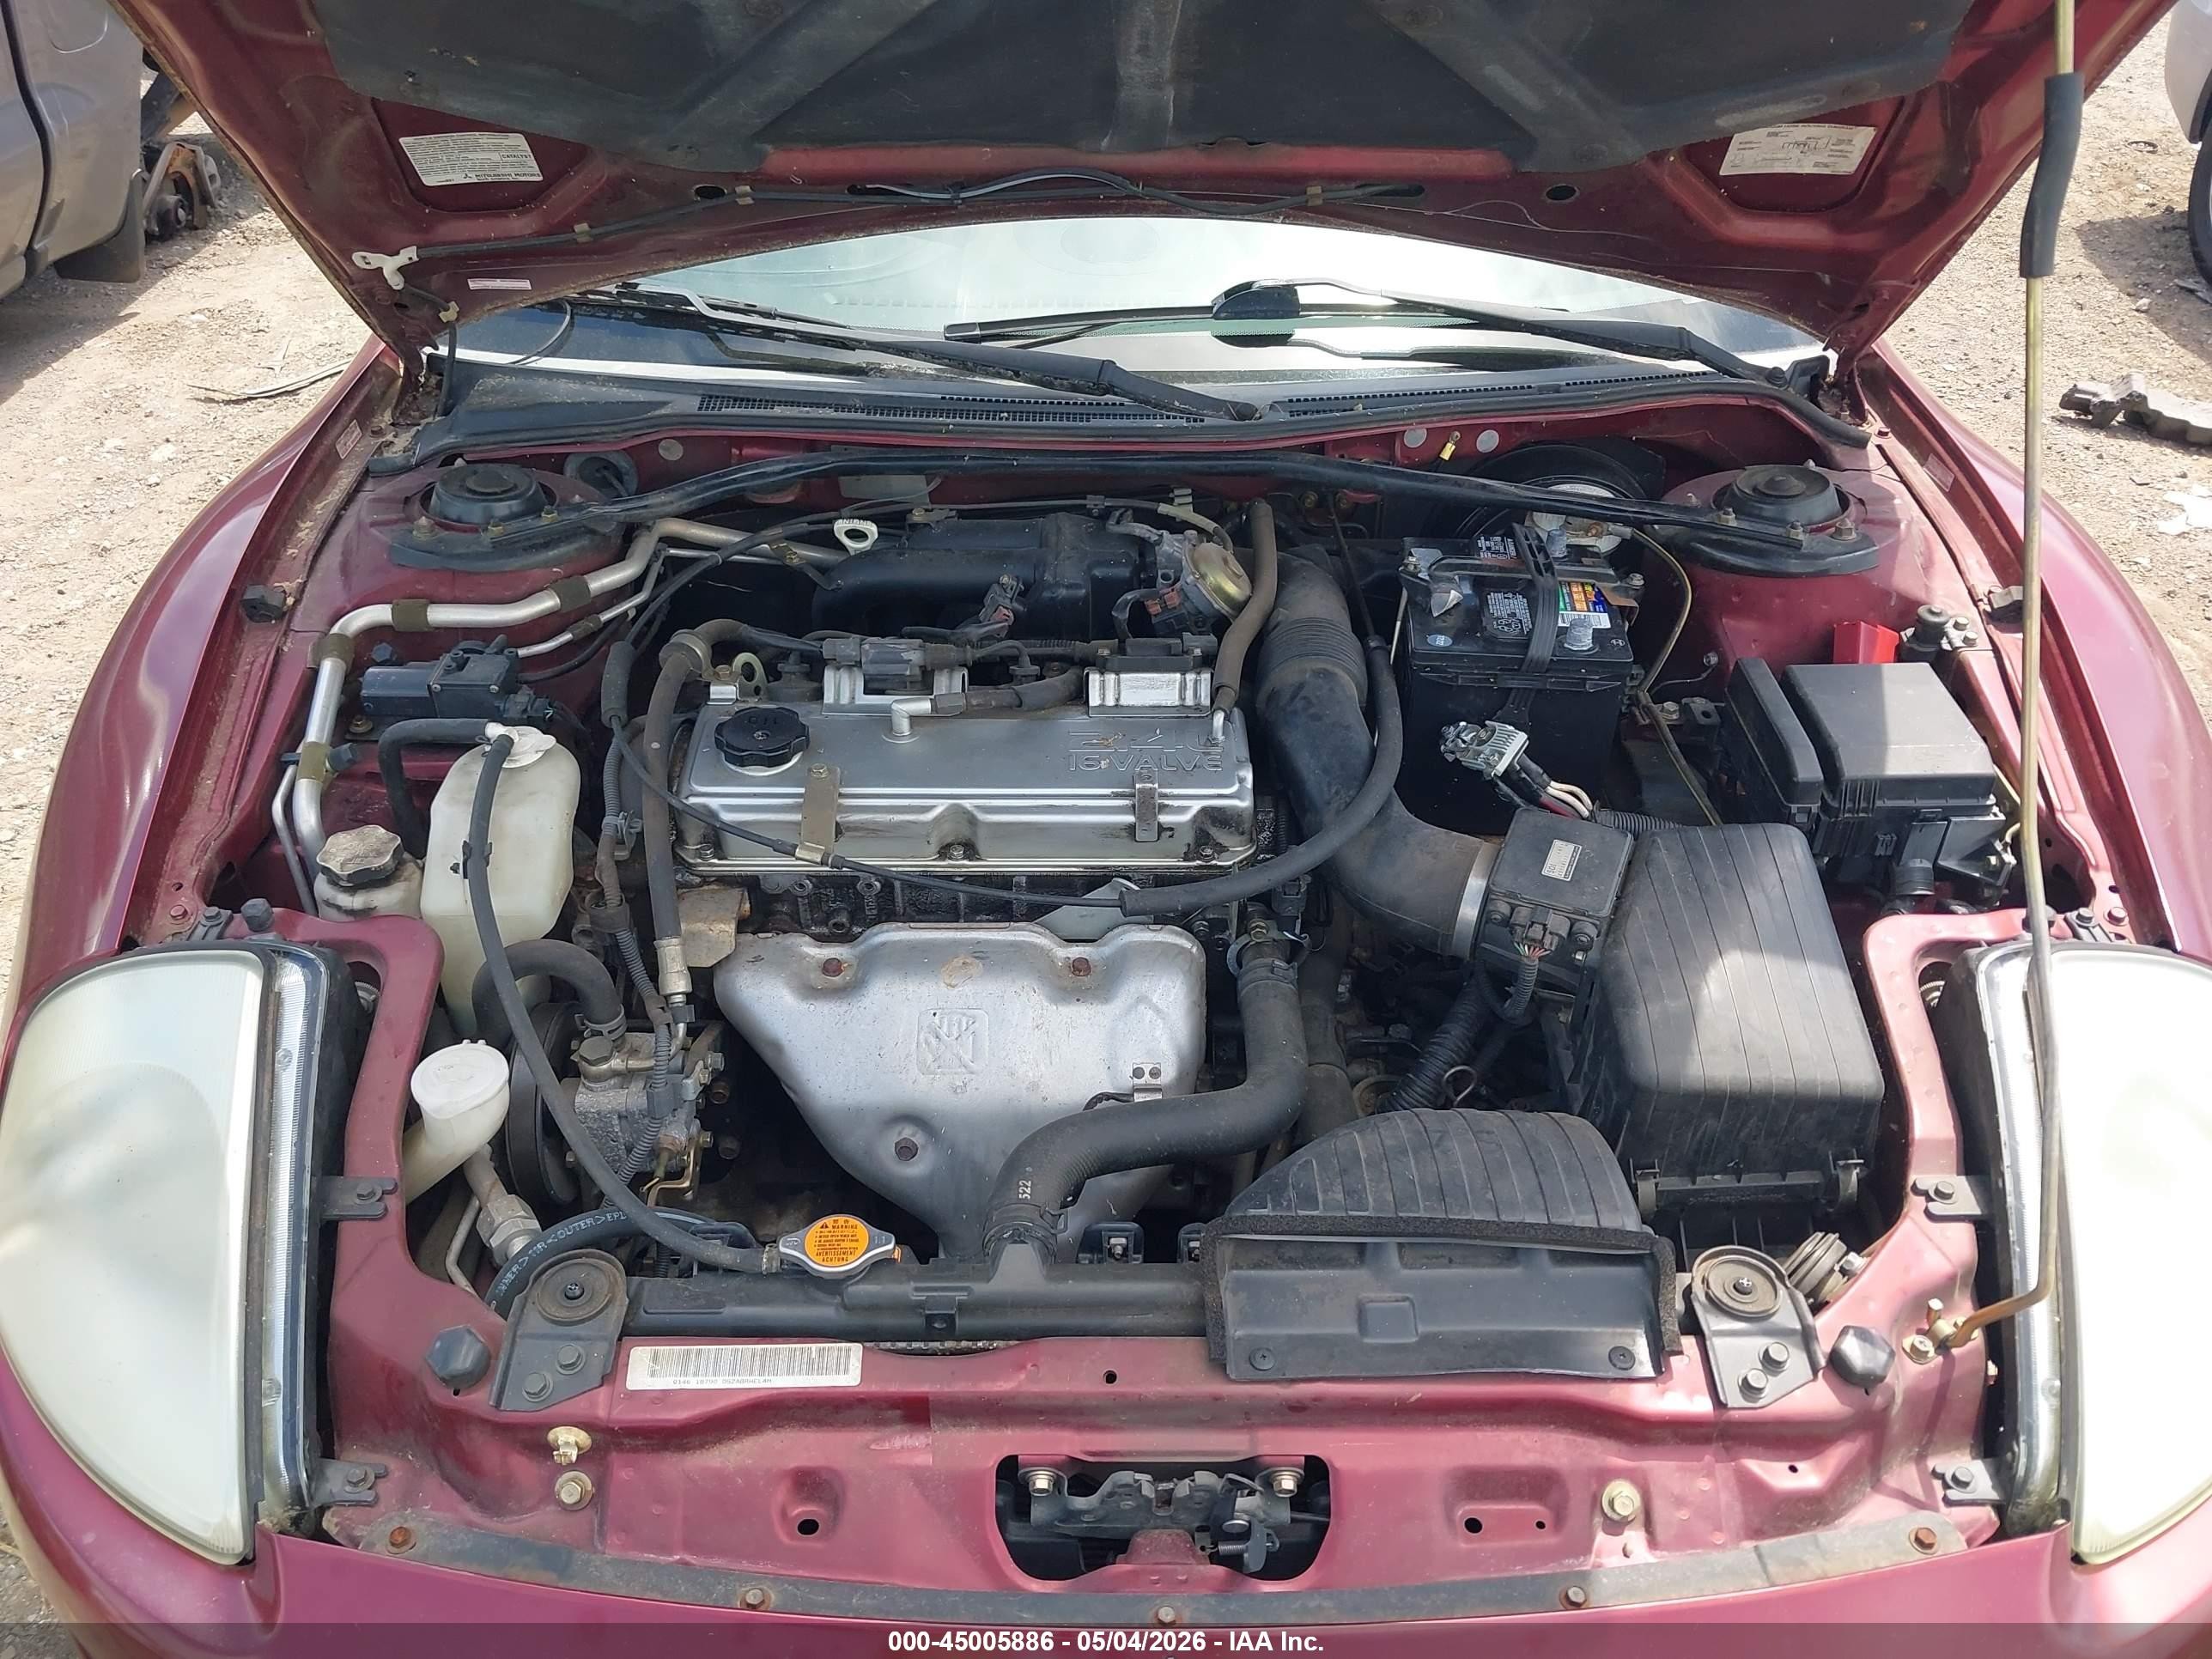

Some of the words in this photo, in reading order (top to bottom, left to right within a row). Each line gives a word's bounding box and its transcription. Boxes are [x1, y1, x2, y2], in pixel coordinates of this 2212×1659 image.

[1068, 754, 1102, 771] 16
[1108, 754, 1224, 771] VALVE
[1018, 1180, 1032, 1200] 522
